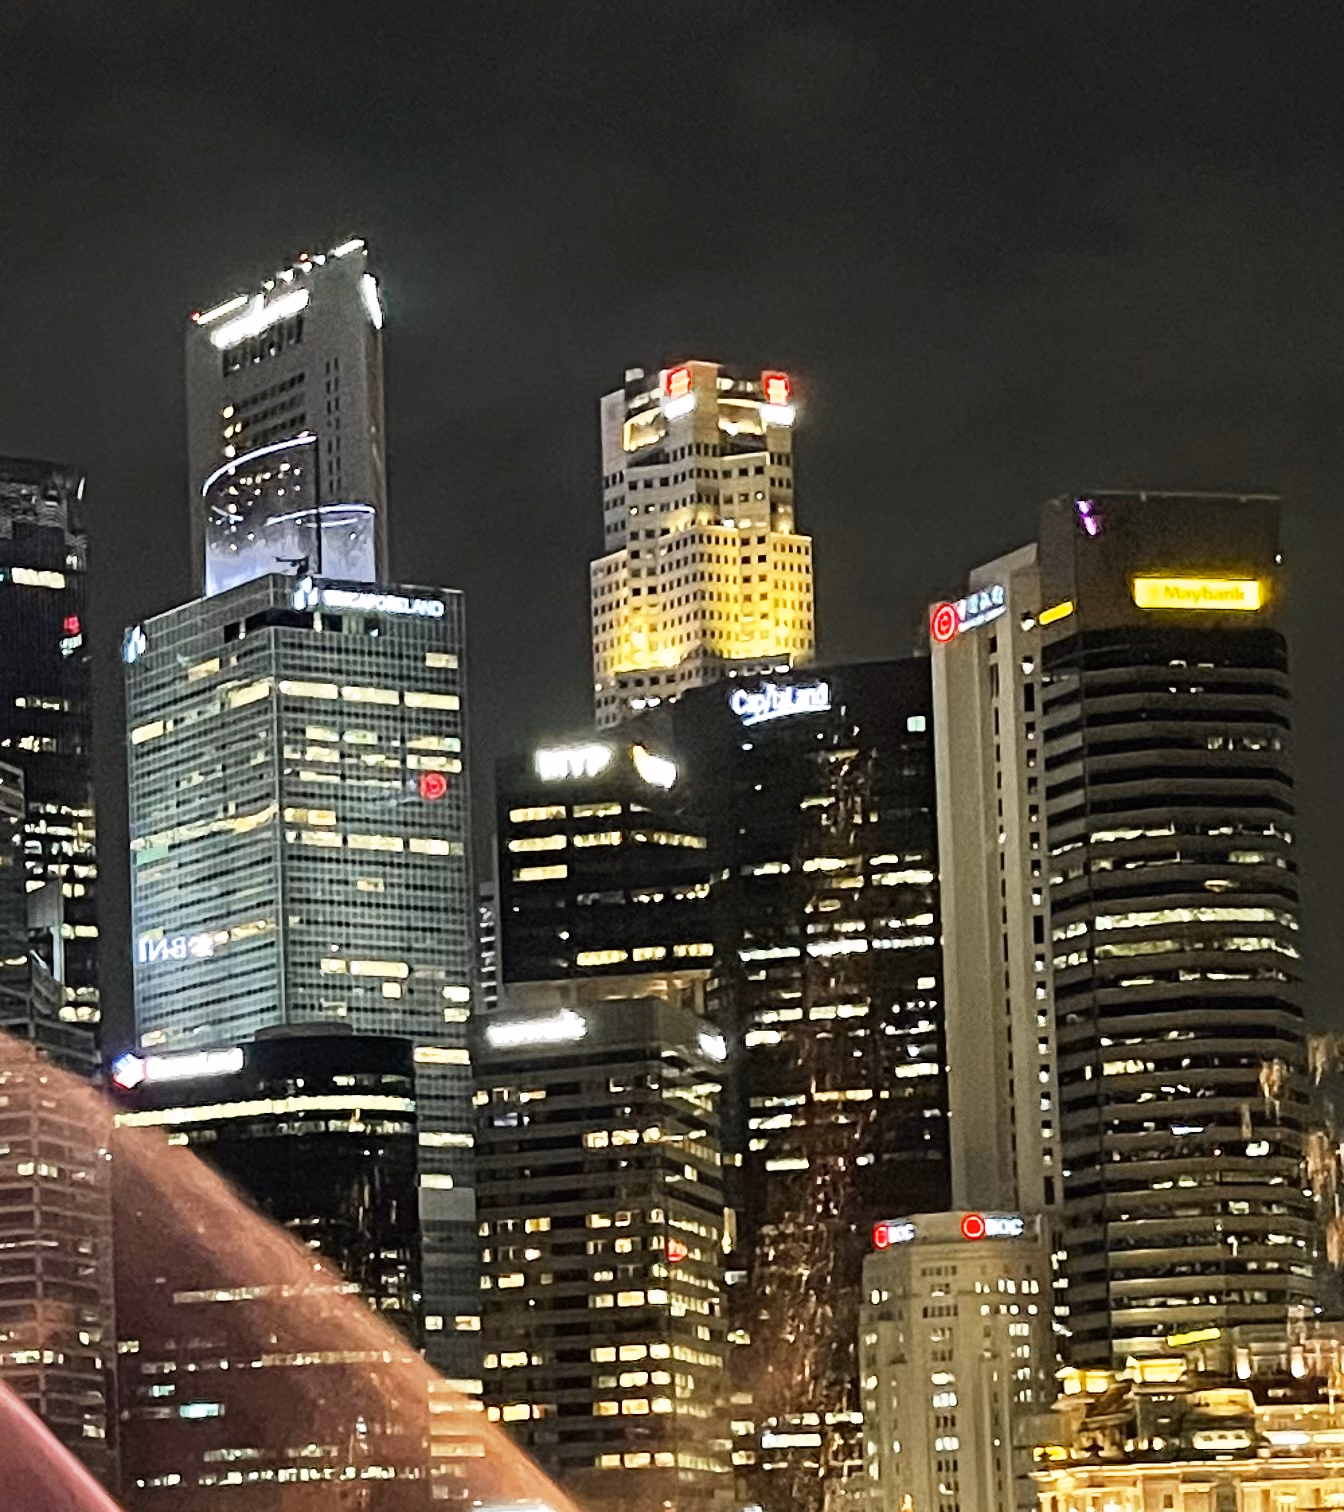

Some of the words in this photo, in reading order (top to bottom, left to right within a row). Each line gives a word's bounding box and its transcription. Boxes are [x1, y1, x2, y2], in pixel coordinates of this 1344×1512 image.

[323, 589, 444, 617] APORELAND
[1163, 585, 1245, 603] Maybank
[732, 682, 828, 718] CapitaLand
